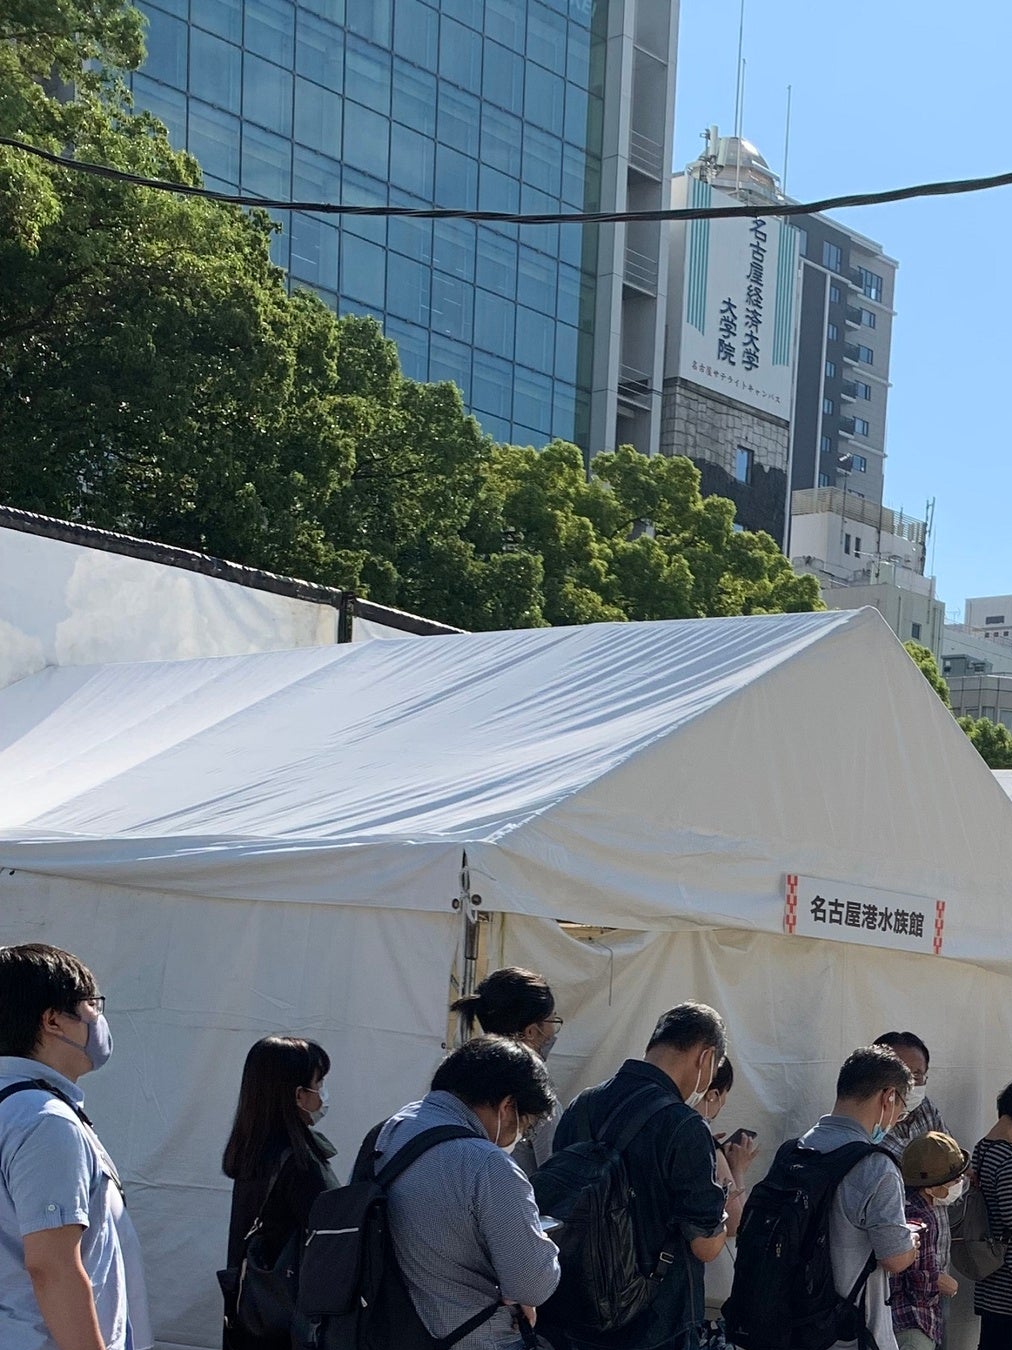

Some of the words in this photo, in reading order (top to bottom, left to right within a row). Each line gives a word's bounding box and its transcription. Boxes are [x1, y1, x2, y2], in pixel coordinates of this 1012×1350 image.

[742, 218, 767, 372] 名古屋経済大学
[717, 297, 738, 366] 大学院
[691, 360, 781, 404] 名古屋サテライトキャンパス
[810, 895, 925, 938] 名古屋港水族館
